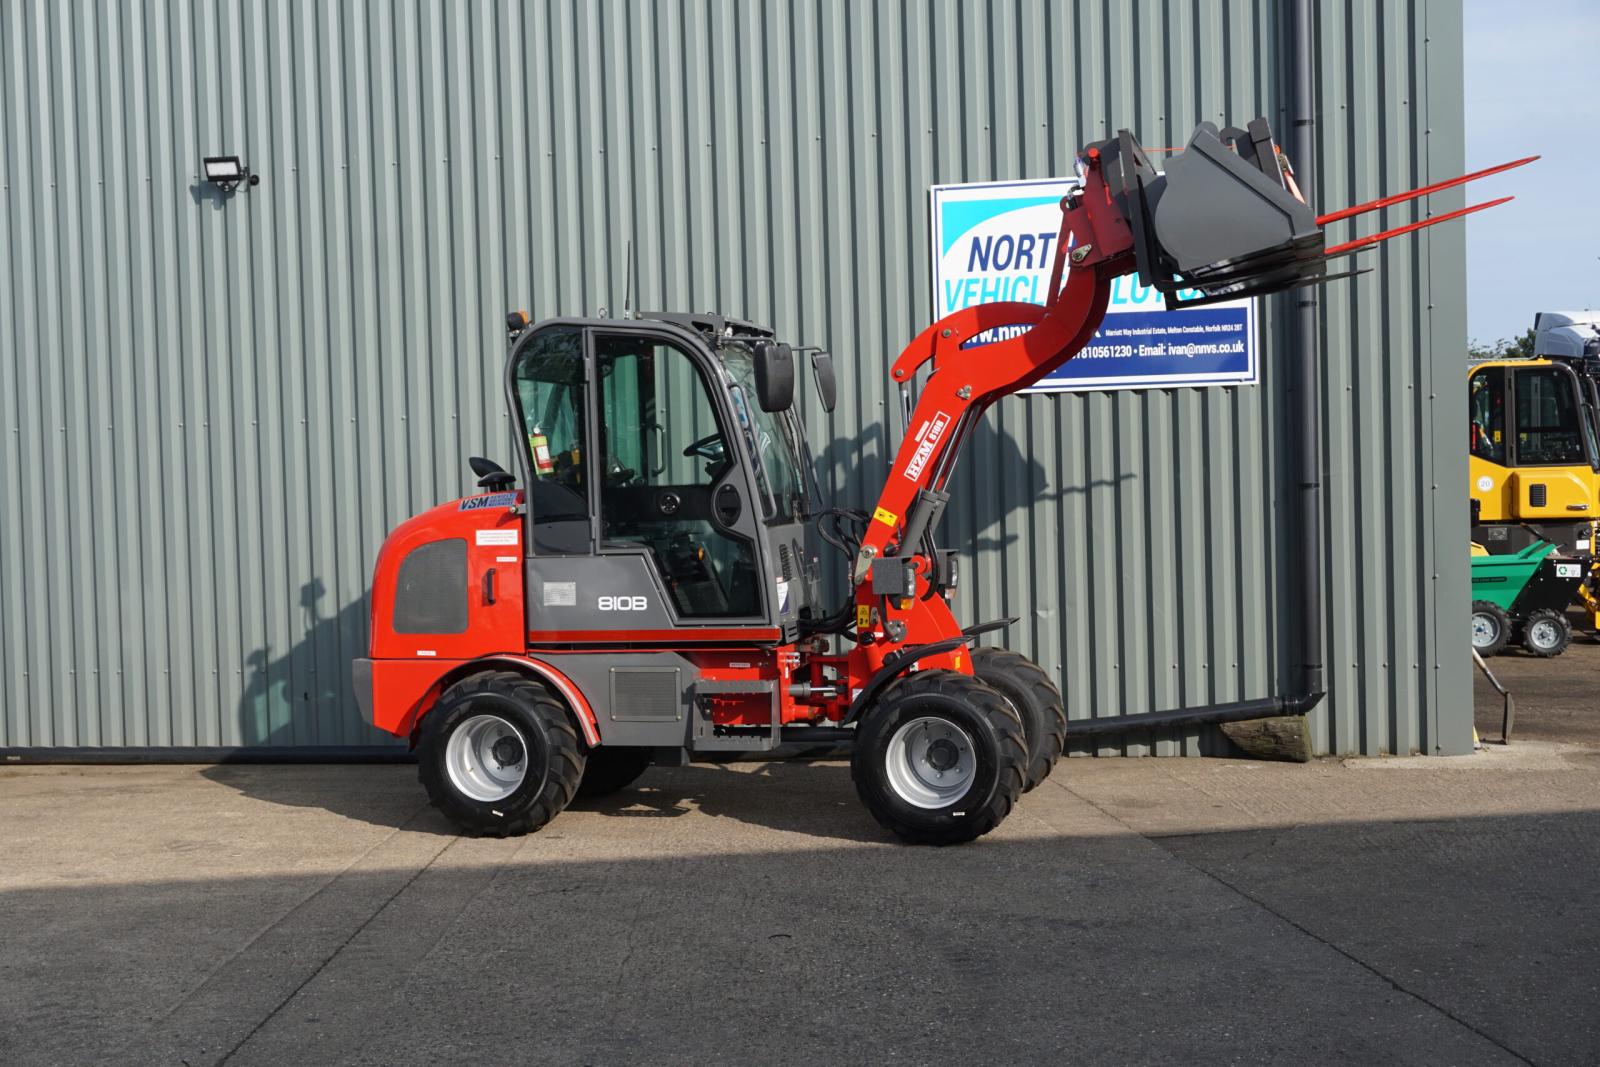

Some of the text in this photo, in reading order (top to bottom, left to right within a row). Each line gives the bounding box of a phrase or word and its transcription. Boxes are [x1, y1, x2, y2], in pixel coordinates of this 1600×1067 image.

[967, 232, 1077, 272] NORT
[945, 275, 1045, 312] VEHICL
[1123, 328, 1132, 337] Way
[1132, 327, 1152, 336] Industrial
[1152, 327, 1167, 335] Estate,
[1167, 326, 1182, 334] Melton
[1205, 323, 1221, 332] Norfolk
[1072, 340, 1244, 359] 810561230 Email: ivan@nnvs.co.uk
[907, 440, 934, 477] HZM
[461, 496, 489, 510] VSM
[598, 596, 647, 611] 810B
